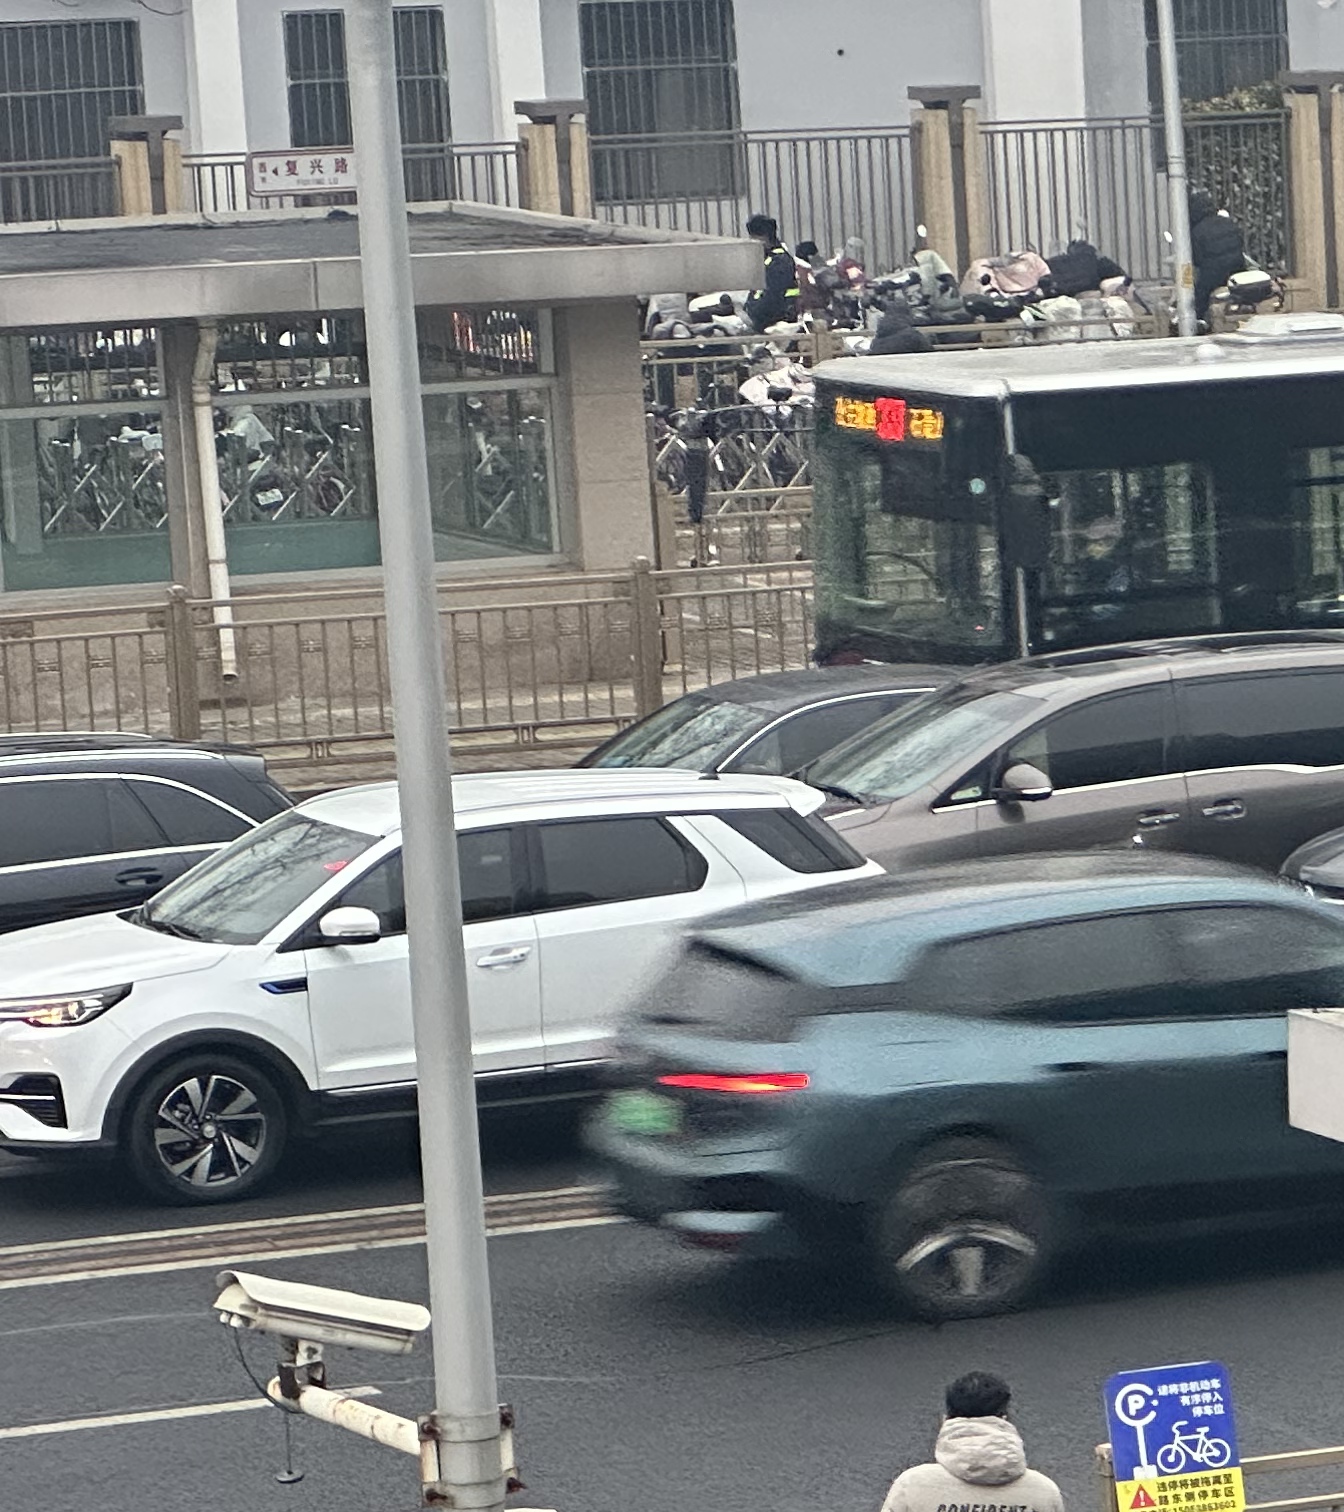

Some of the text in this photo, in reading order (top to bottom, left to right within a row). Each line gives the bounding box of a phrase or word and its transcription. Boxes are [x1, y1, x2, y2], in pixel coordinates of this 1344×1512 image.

[285, 157, 348, 177] 复兴路
[1192, 1403, 1225, 1418] 停车位
